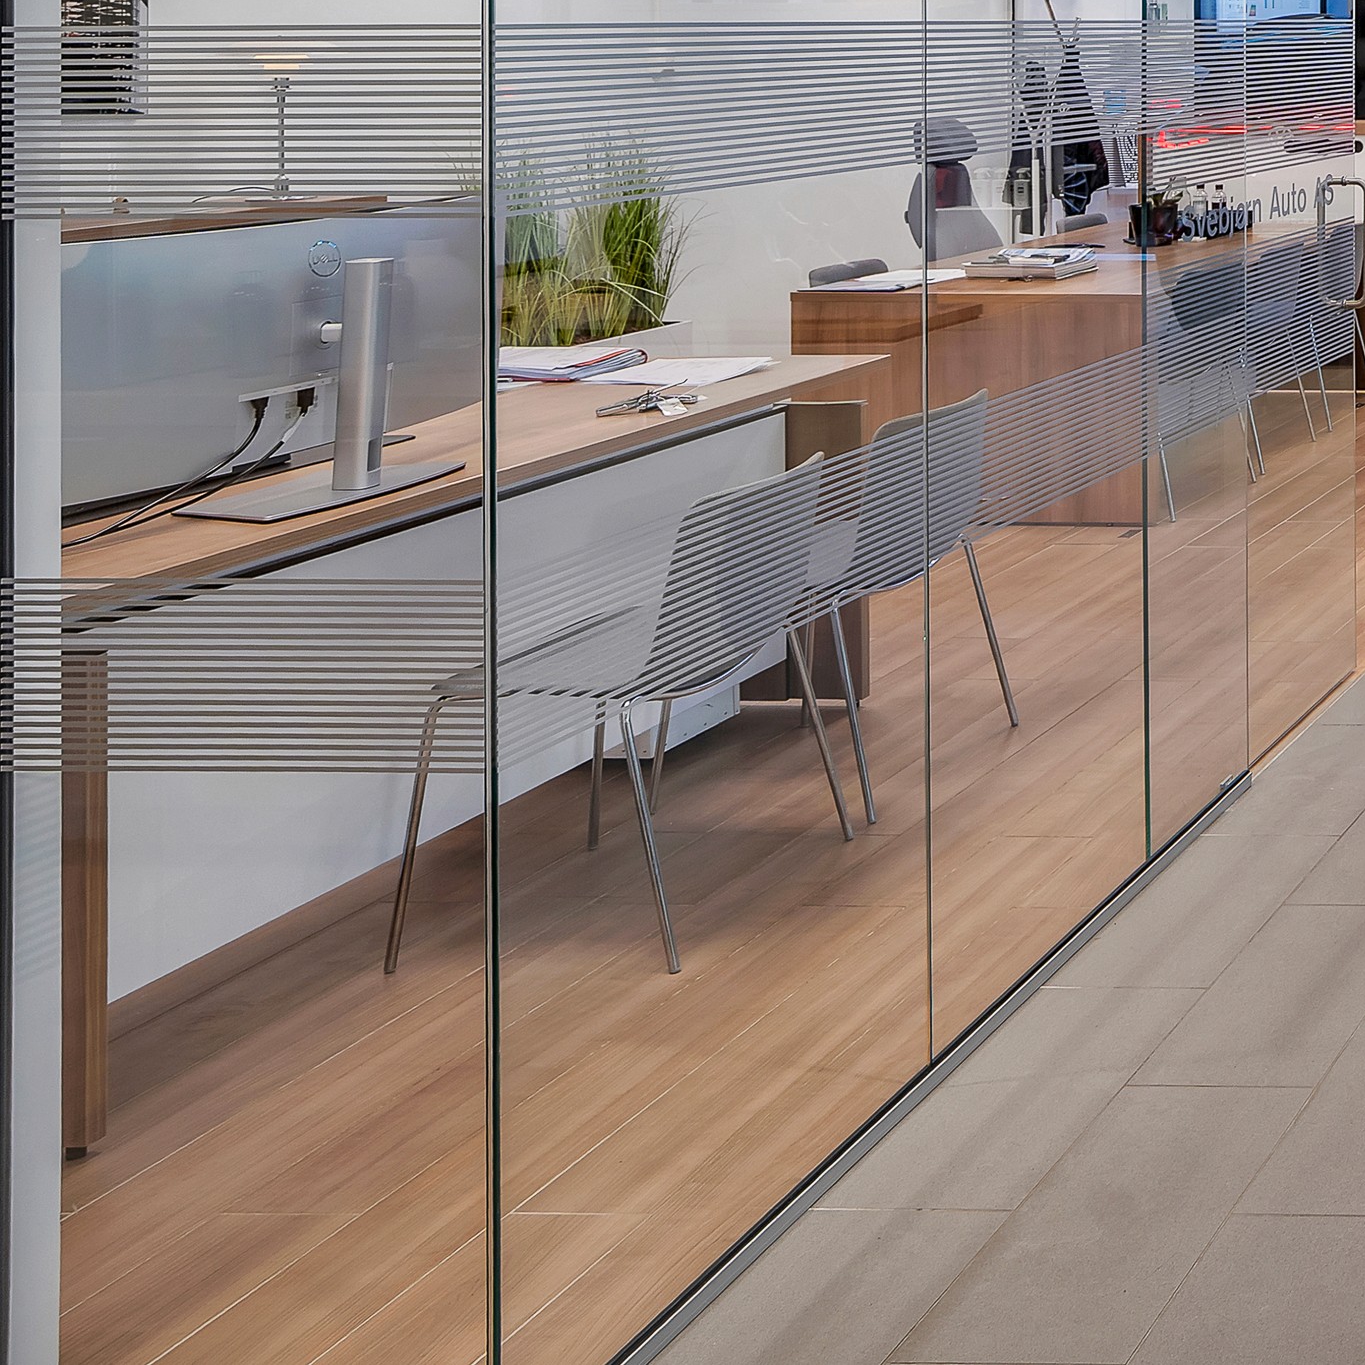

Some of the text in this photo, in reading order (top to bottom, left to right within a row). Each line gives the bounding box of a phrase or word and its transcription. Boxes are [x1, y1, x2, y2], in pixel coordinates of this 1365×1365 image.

[1181, 174, 1334, 243] Svebjørn Auto AS
